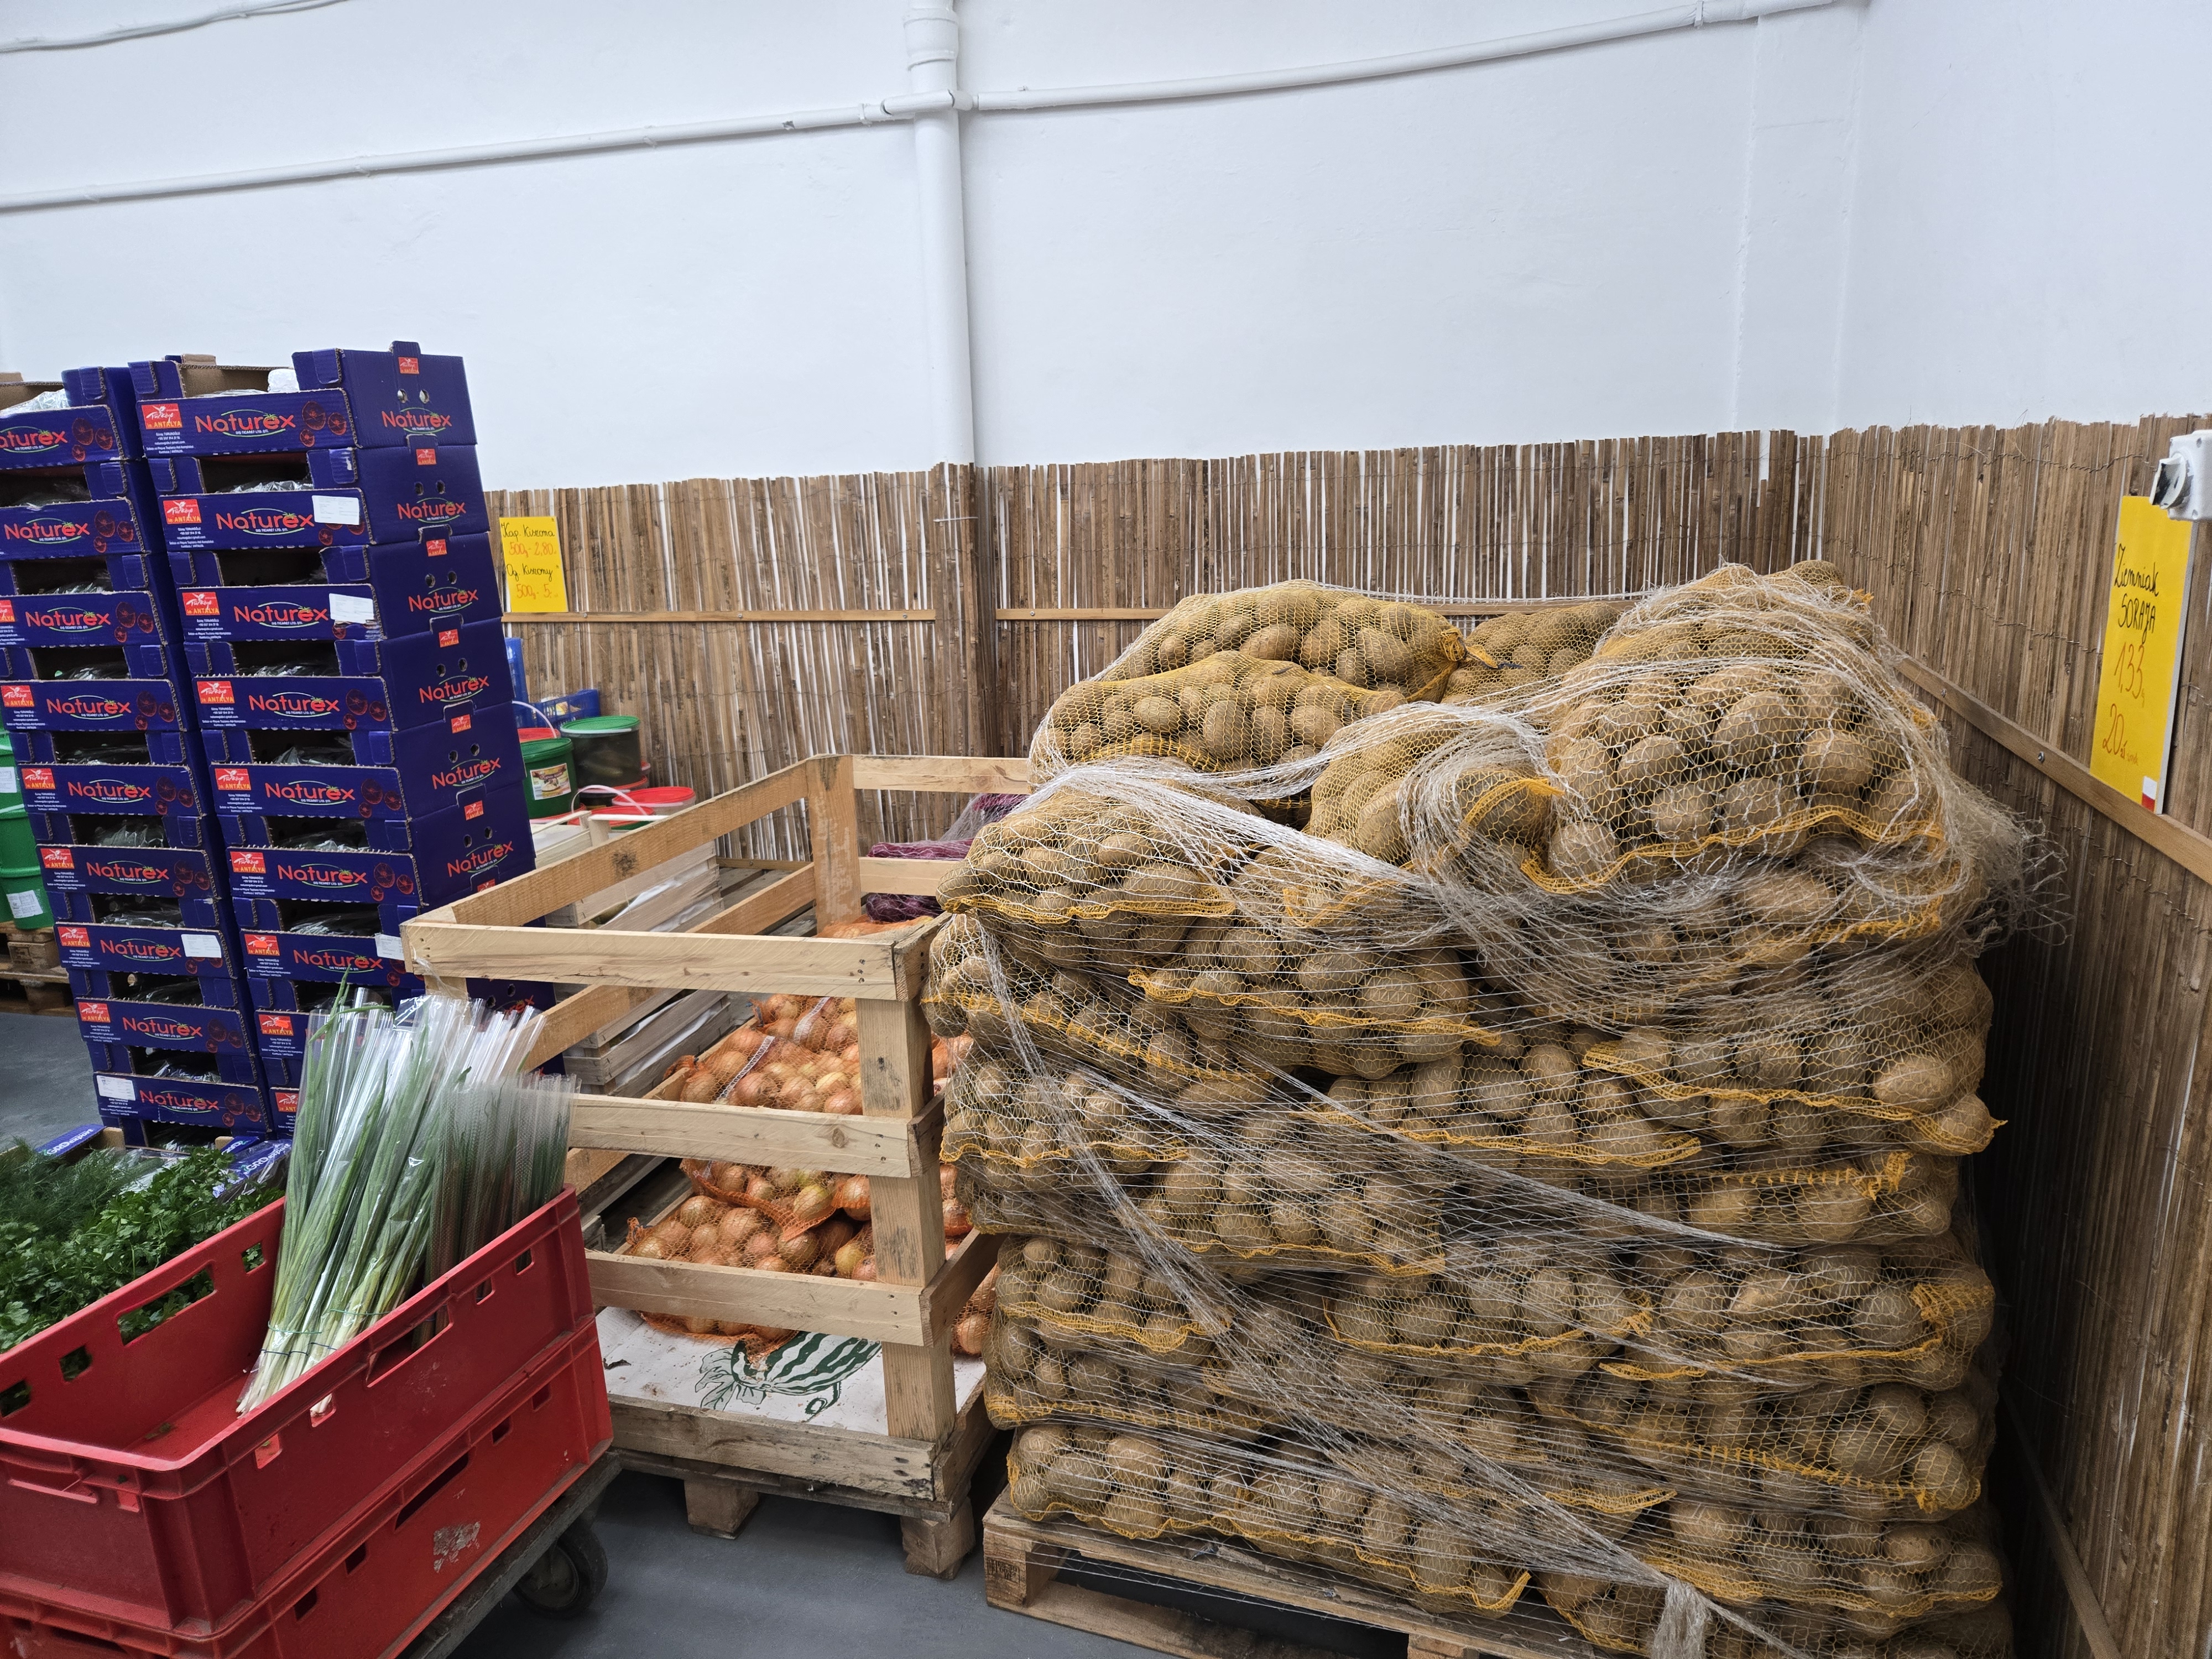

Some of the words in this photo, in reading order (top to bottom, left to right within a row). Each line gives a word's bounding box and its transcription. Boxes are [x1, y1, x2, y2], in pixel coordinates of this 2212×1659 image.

[195, 414, 296, 432] Naturex
[382, 411, 452, 427] Naturex
[0, 431, 67, 448] aturex
[398, 502, 466, 519] Naturex
[216, 512, 315, 529] Naturex
[4, 522, 90, 540] Naturex
[522, 563, 552, 582] Kiszony
[2114, 543, 2159, 597] Ziemniak
[408, 589, 478, 612] Naturex
[25, 611, 111, 627] Naturex
[234, 606, 328, 622] Naturex
[2114, 641, 2144, 699] 1,33
[419, 676, 489, 703] Naturex
[46, 698, 131, 714] Naturex
[249, 695, 340, 712] Naturex
[432, 758, 501, 789] Naturex
[68, 781, 151, 798] Naturex
[265, 782, 355, 800] Naturex
[447, 841, 514, 877] Naturex
[86, 862, 169, 880] Naturex
[278, 864, 367, 883] Naturex
[100, 940, 181, 957] Naturex
[293, 949, 383, 969] Naturex
[122, 1016, 202, 1036] Naturex
[139, 1090, 220, 1110] Naturex
